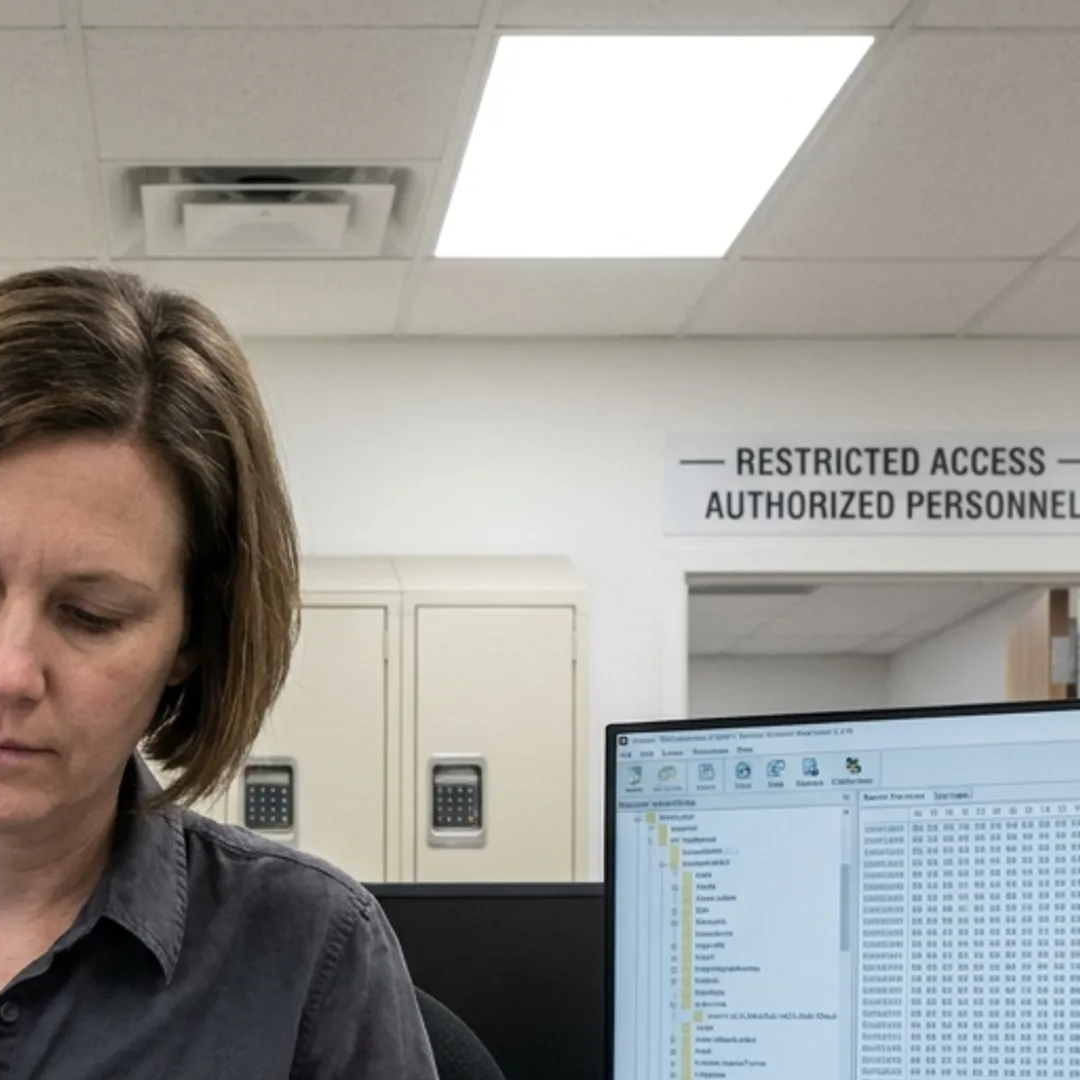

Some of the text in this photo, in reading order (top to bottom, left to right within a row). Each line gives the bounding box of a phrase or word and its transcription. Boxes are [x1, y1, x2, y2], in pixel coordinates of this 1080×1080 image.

[738, 447, 1045, 475] RESTRICTED ACCESS
[706, 491, 1080, 519] AUTHORIZED PERSONNEL
